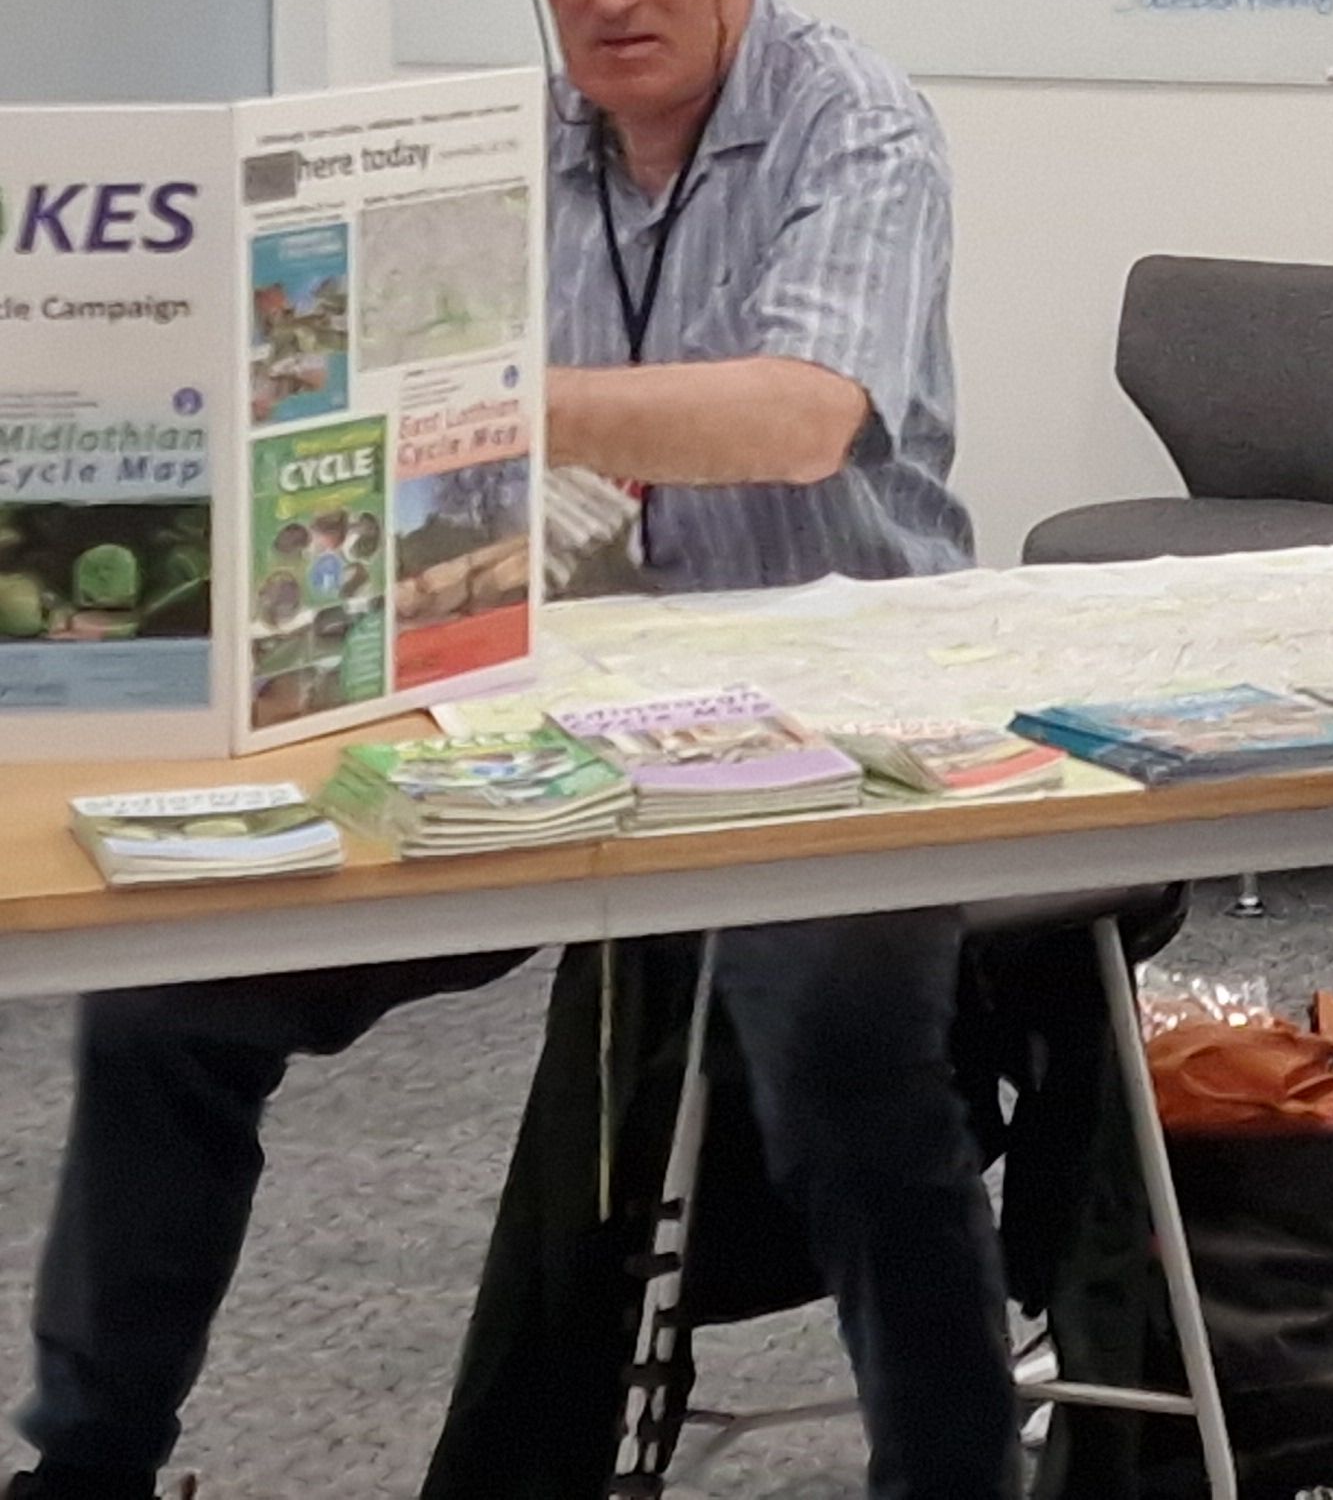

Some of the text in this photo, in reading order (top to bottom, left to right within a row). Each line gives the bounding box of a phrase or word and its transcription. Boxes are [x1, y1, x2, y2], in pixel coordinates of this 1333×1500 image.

[360, 139, 431, 171] today
[0, 182, 199, 253] KES
[41, 297, 190, 324] Campaign
[0, 422, 205, 452] Midlothian
[118, 456, 203, 486] Map
[278, 447, 376, 492] CYCLE
